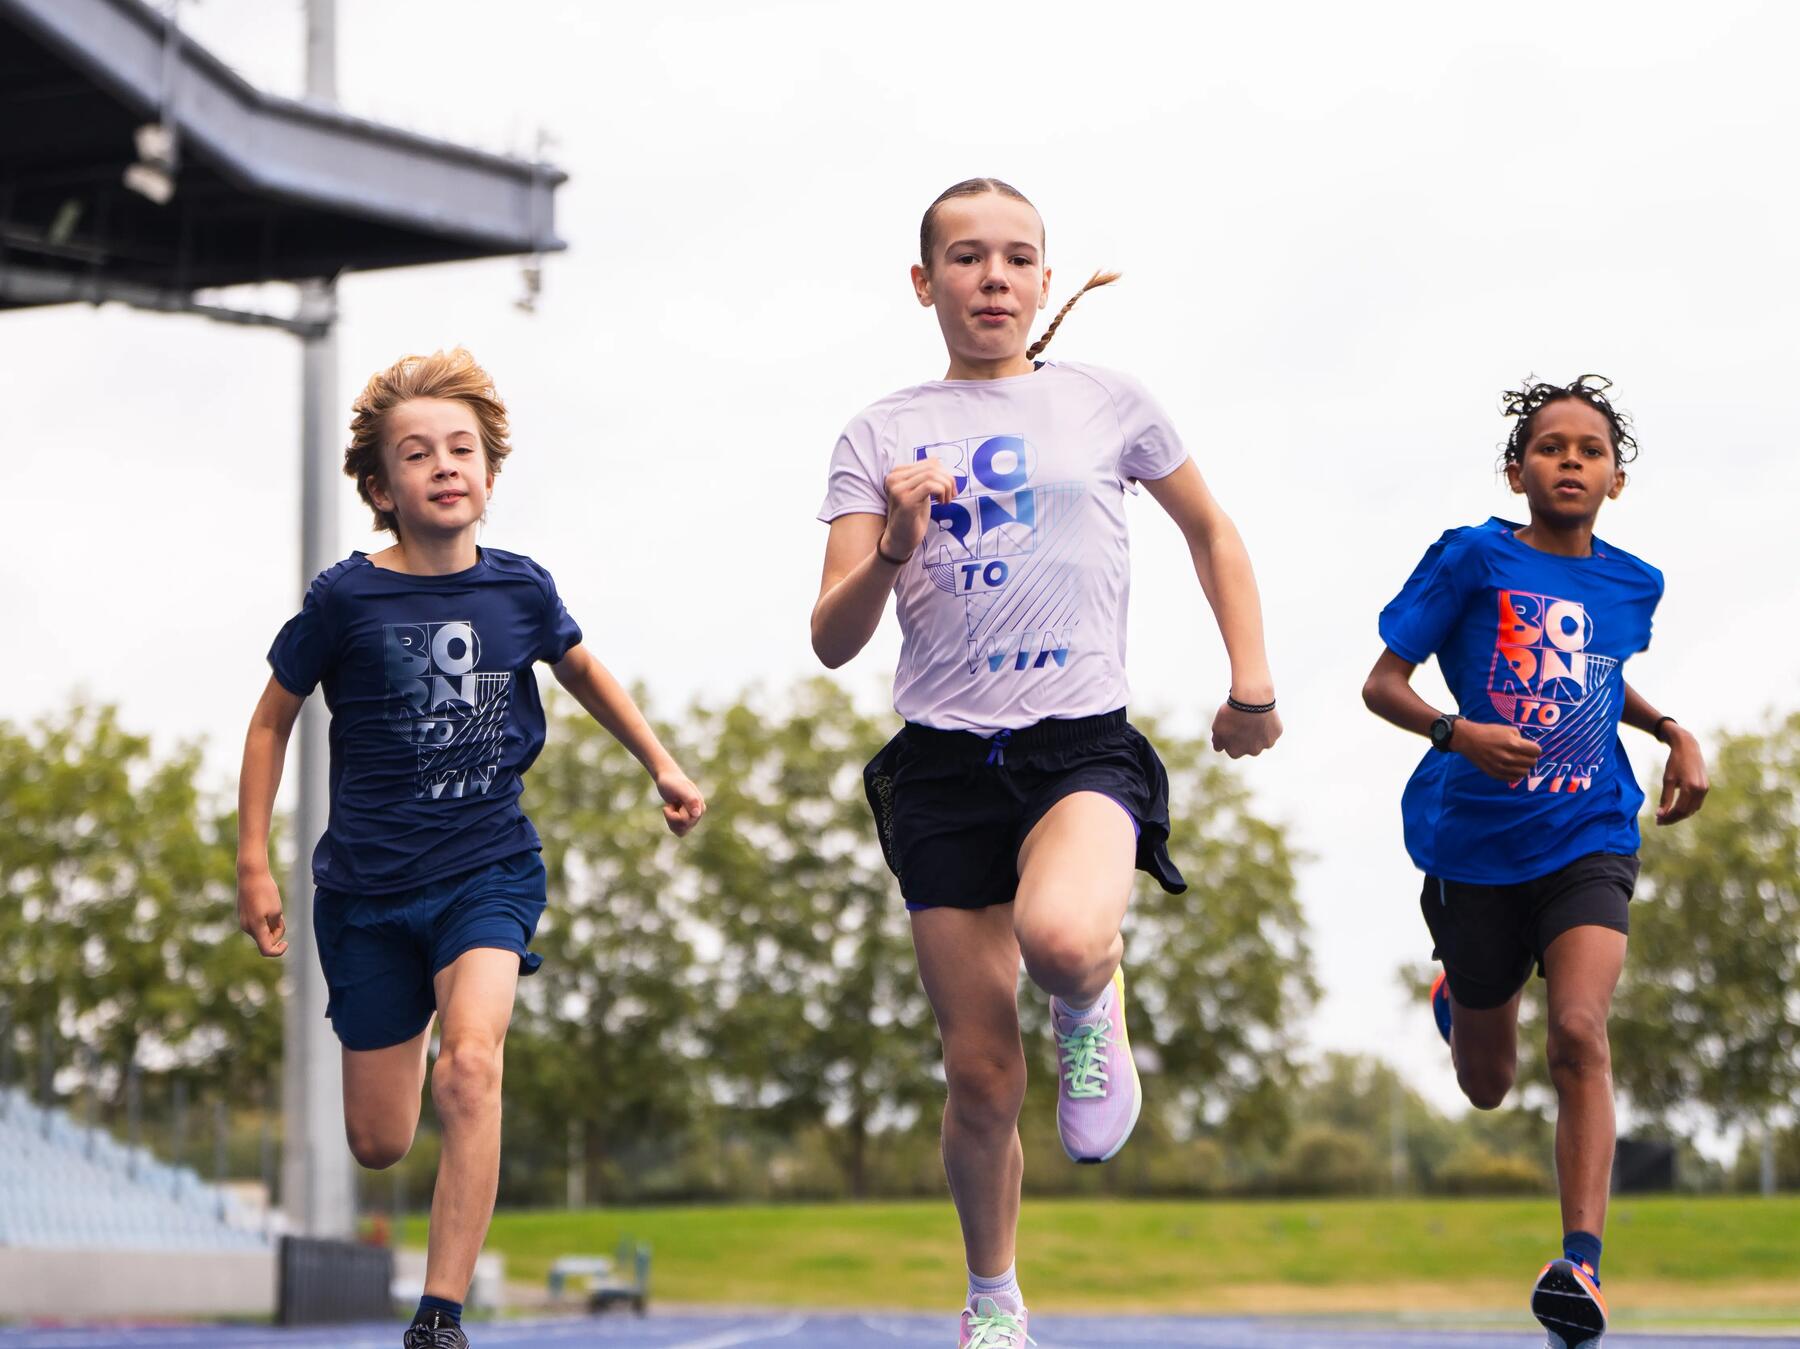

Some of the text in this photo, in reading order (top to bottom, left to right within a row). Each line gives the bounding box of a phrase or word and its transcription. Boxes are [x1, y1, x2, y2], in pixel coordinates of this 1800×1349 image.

[960, 561, 1009, 590] TO
[1498, 590, 1593, 653] BO
[385, 623, 481, 676] BO
[967, 628, 1073, 675] WIN
[1488, 646, 1587, 704] RN
[386, 676, 477, 719] RN
[1520, 701, 1561, 726] TO
[417, 721, 454, 743] TO
[416, 766, 497, 799] WIN
